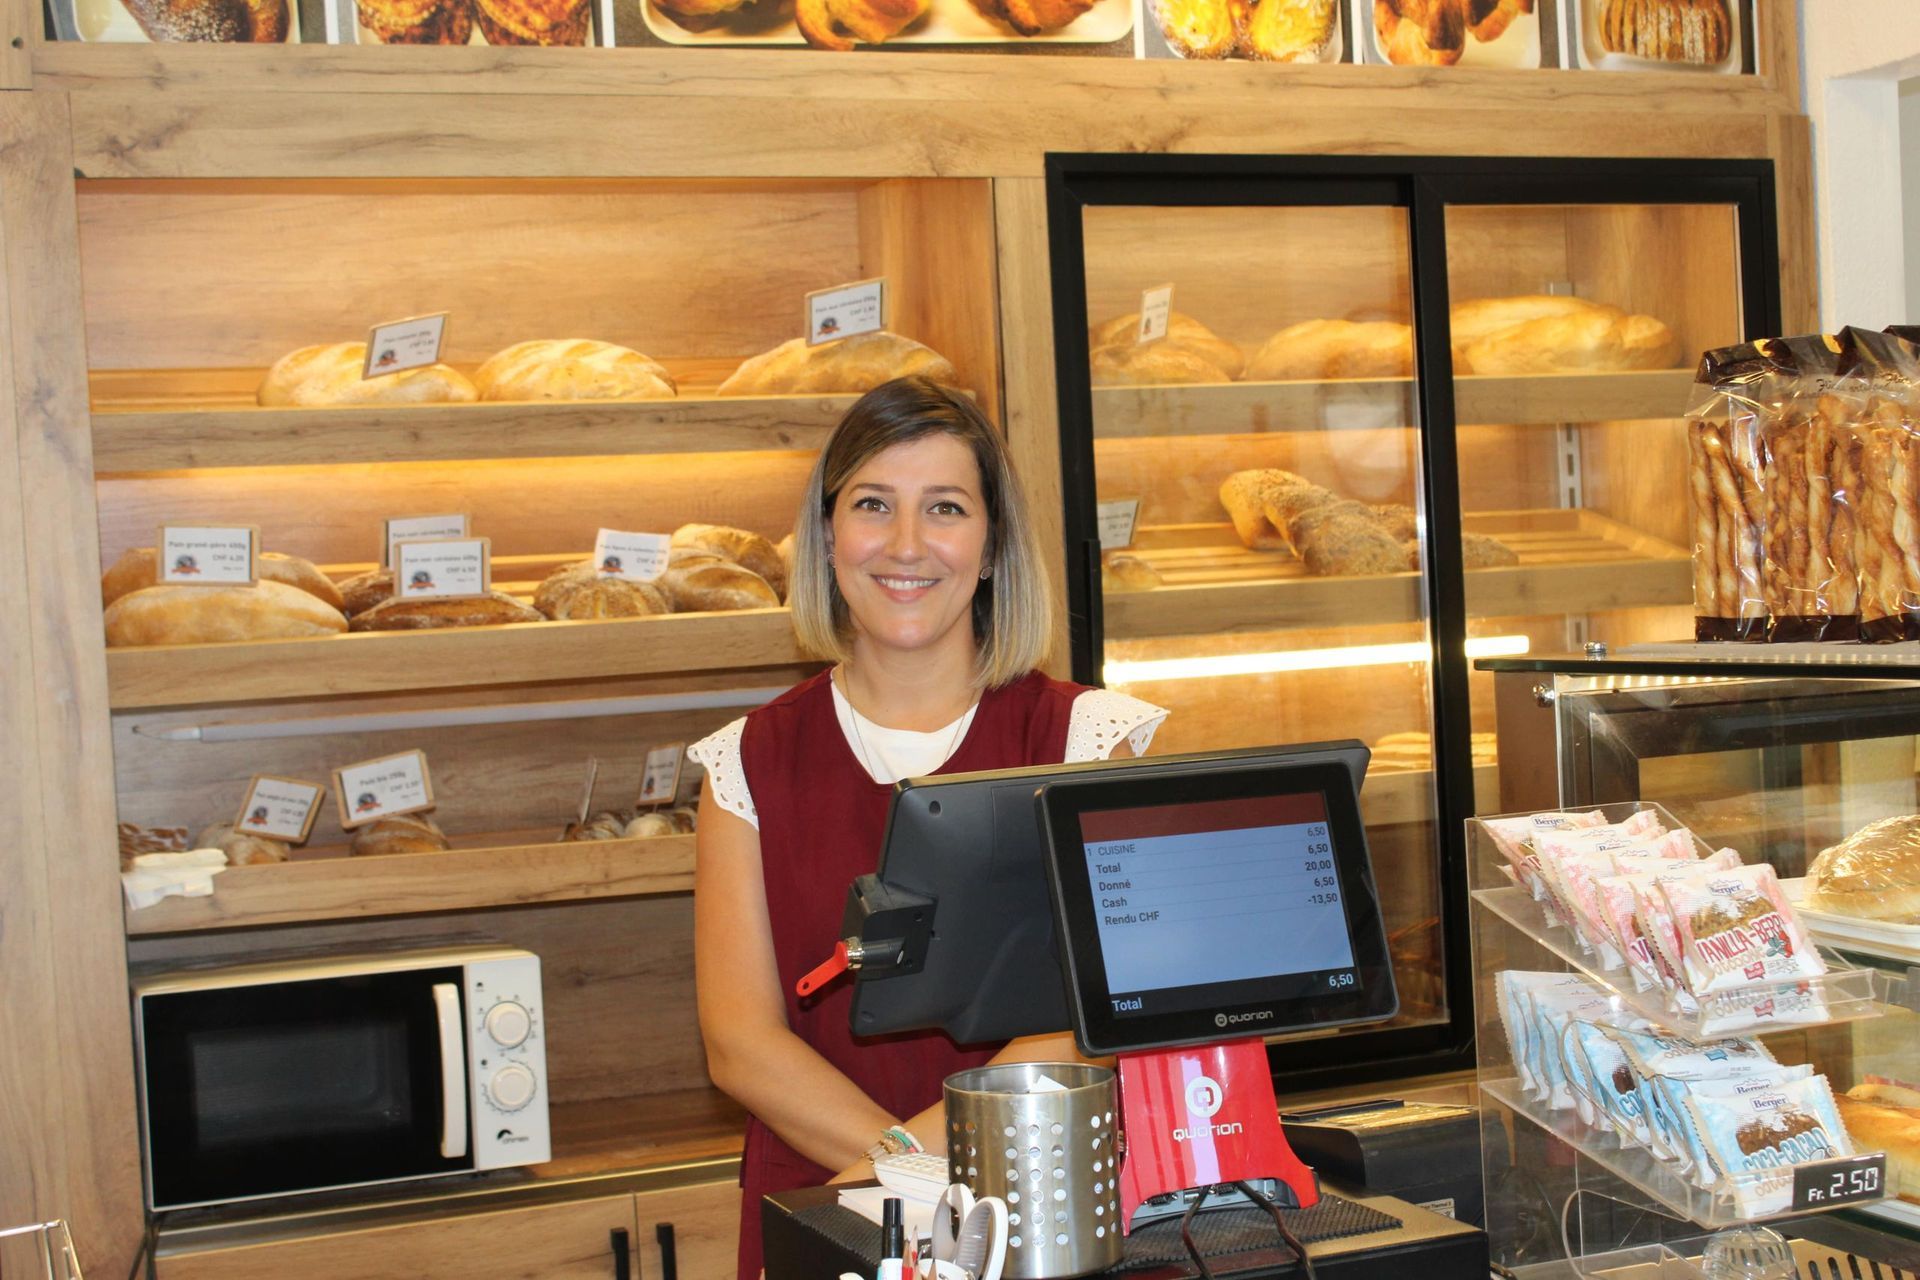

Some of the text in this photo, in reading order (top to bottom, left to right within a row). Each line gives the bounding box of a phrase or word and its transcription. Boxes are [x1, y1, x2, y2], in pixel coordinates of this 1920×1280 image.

[1534, 817, 1566, 827] Berger
[1087, 826, 1326, 856] 1 CUISINE 6,50
[1095, 843, 1328, 874] Total 6,50
[1099, 860, 1332, 891] Donné 20,00
[1102, 877, 1335, 908] Cash 6,50
[1104, 893, 1338, 926] Rendu CHF -13,50
[1112, 973, 1354, 1012] Total 6,50
[1753, 1098, 1787, 1109] Berger
[1808, 1167, 1879, 1202] Fr. 2.50
